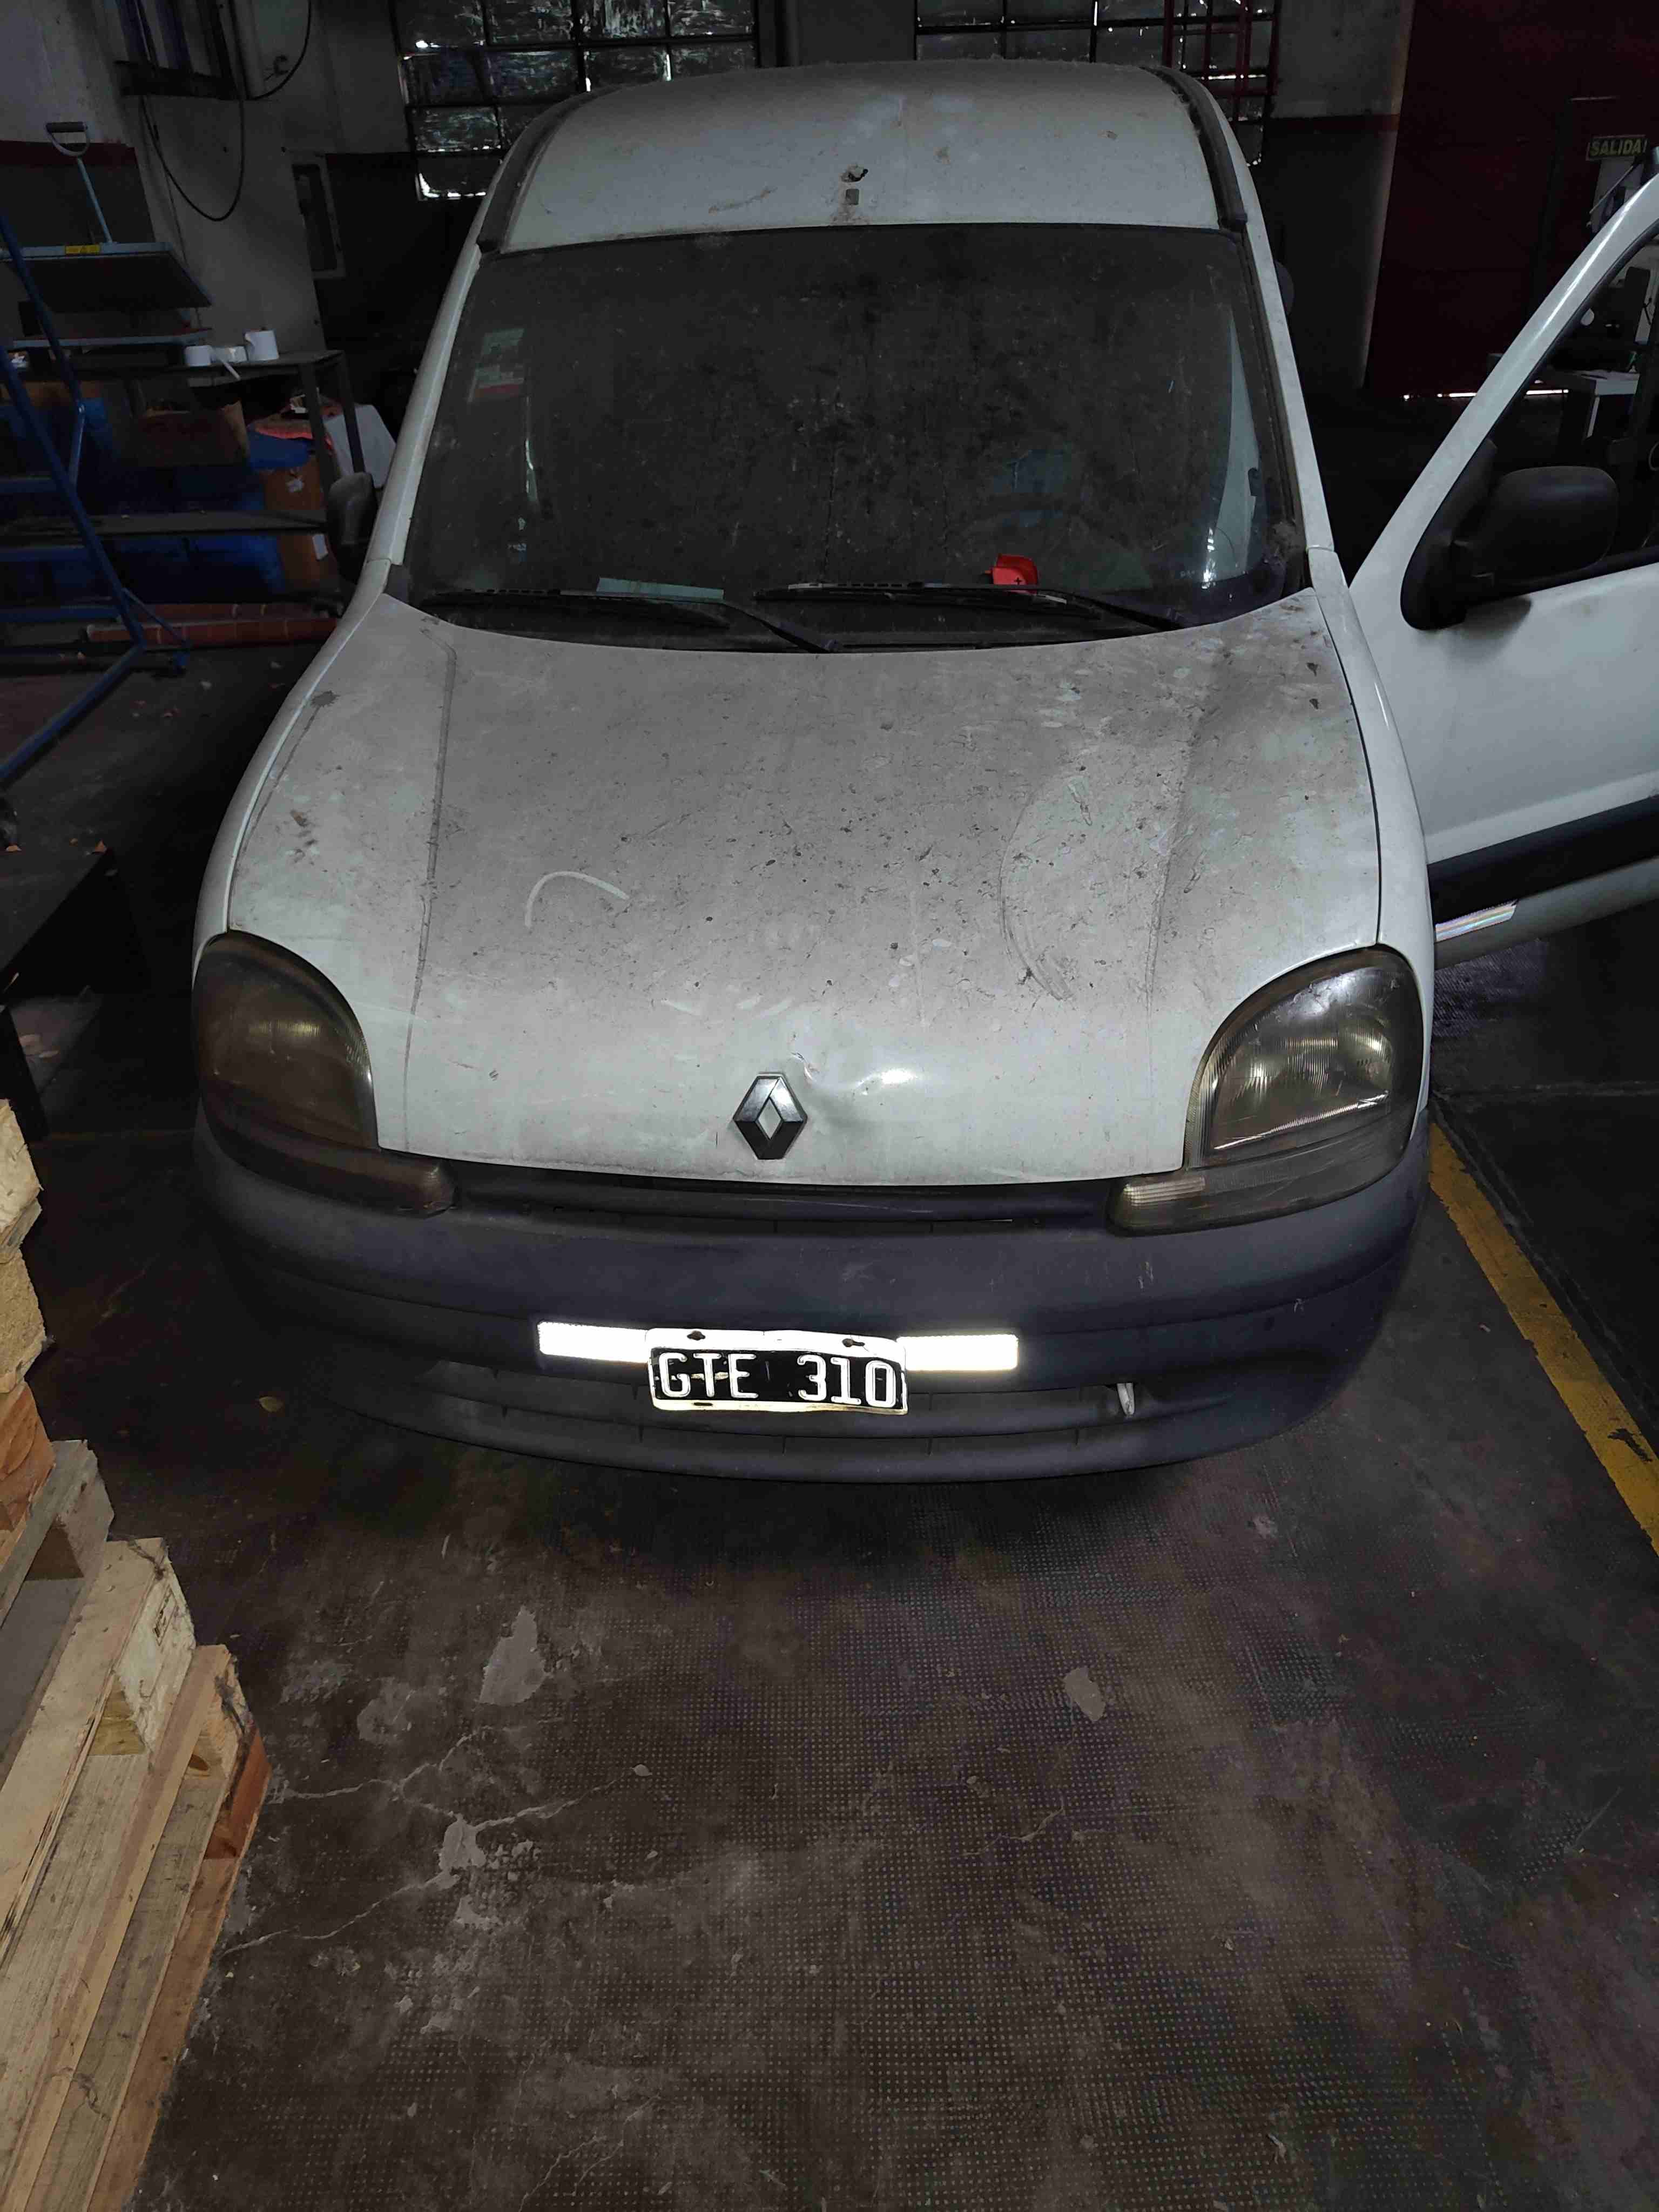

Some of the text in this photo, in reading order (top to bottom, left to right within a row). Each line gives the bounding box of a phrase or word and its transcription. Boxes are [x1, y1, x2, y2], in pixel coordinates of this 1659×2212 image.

[1591, 139, 1642, 156] SALIDA
[658, 1352, 896, 1408] GTE 310
